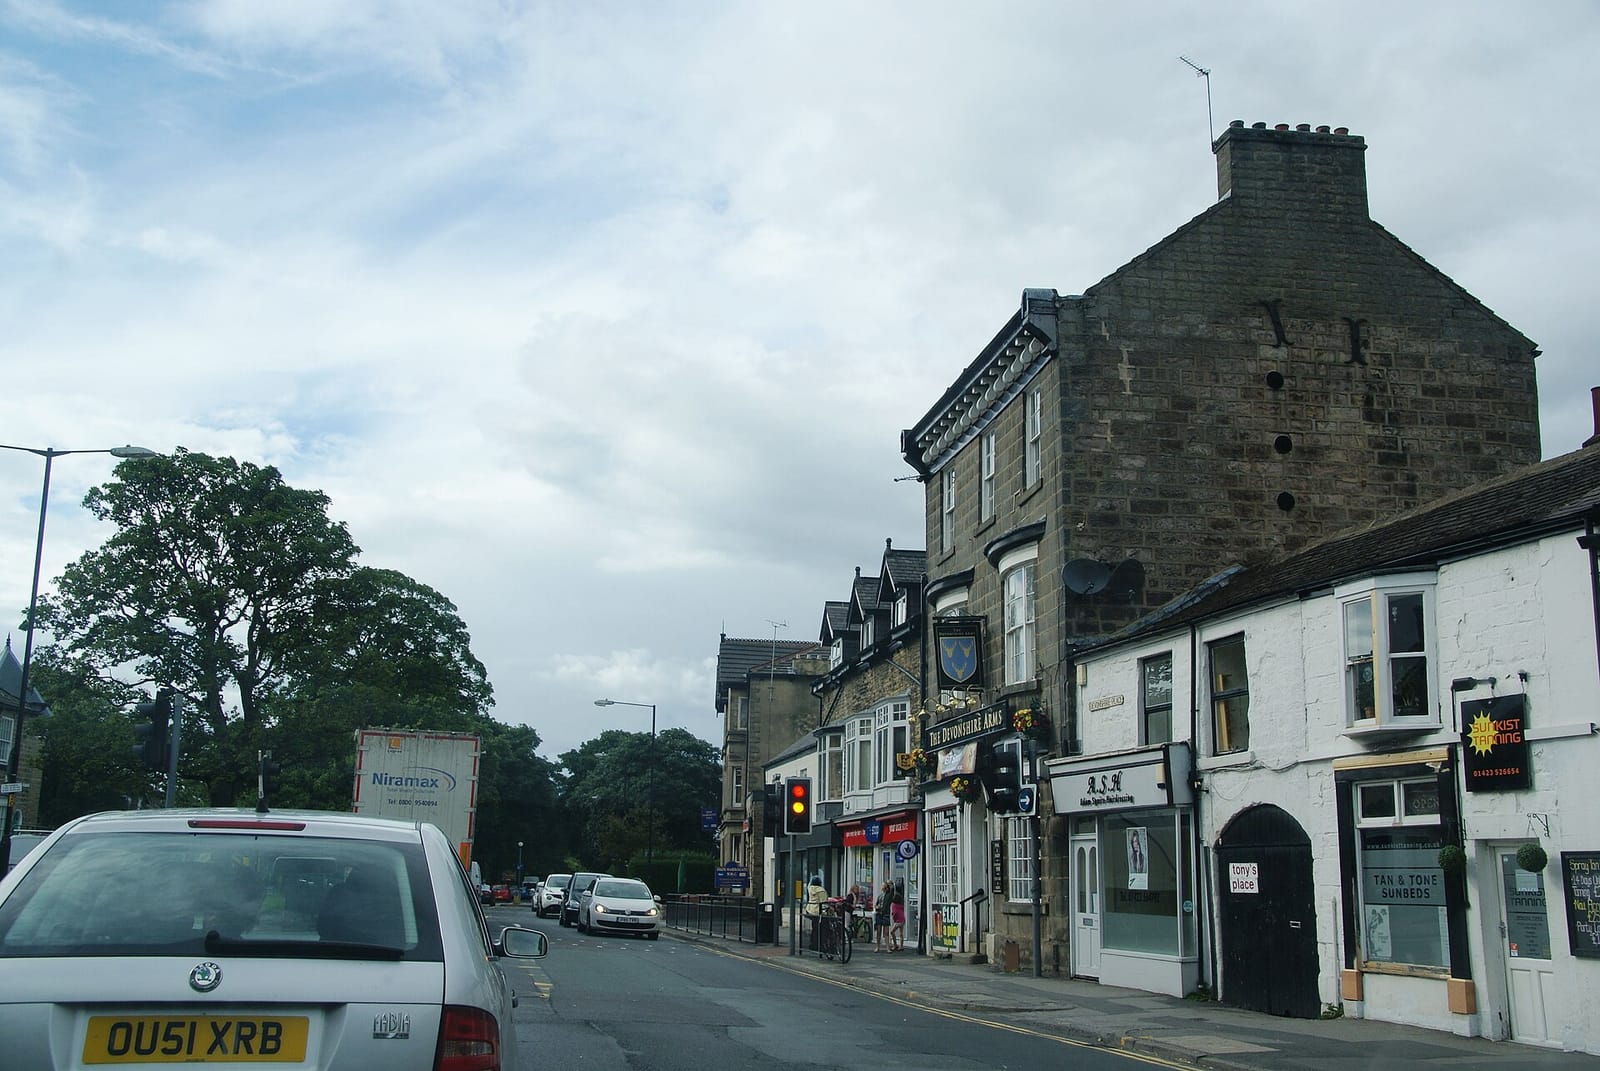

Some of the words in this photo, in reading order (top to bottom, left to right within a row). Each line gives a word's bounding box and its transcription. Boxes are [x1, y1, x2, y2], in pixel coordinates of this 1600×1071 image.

[930, 732, 941, 747] THE
[943, 717, 982, 743] DEVONSHIRE
[983, 710, 1003, 730] ARMS
[1473, 718, 1520, 734] SUNKIST
[1473, 732, 1521, 746] TANNING
[372, 772, 439, 789] Niramax
[1232, 864, 1257, 876] tony's
[1232, 878, 1255, 891] place
[1374, 874, 1394, 886] TAN
[1398, 874, 1405, 886] &
[1409, 874, 1438, 886] TONE
[1382, 888, 1430, 899] SUNBEDS
[107, 1021, 197, 1056] OU51
[206, 1021, 283, 1055] XRB
